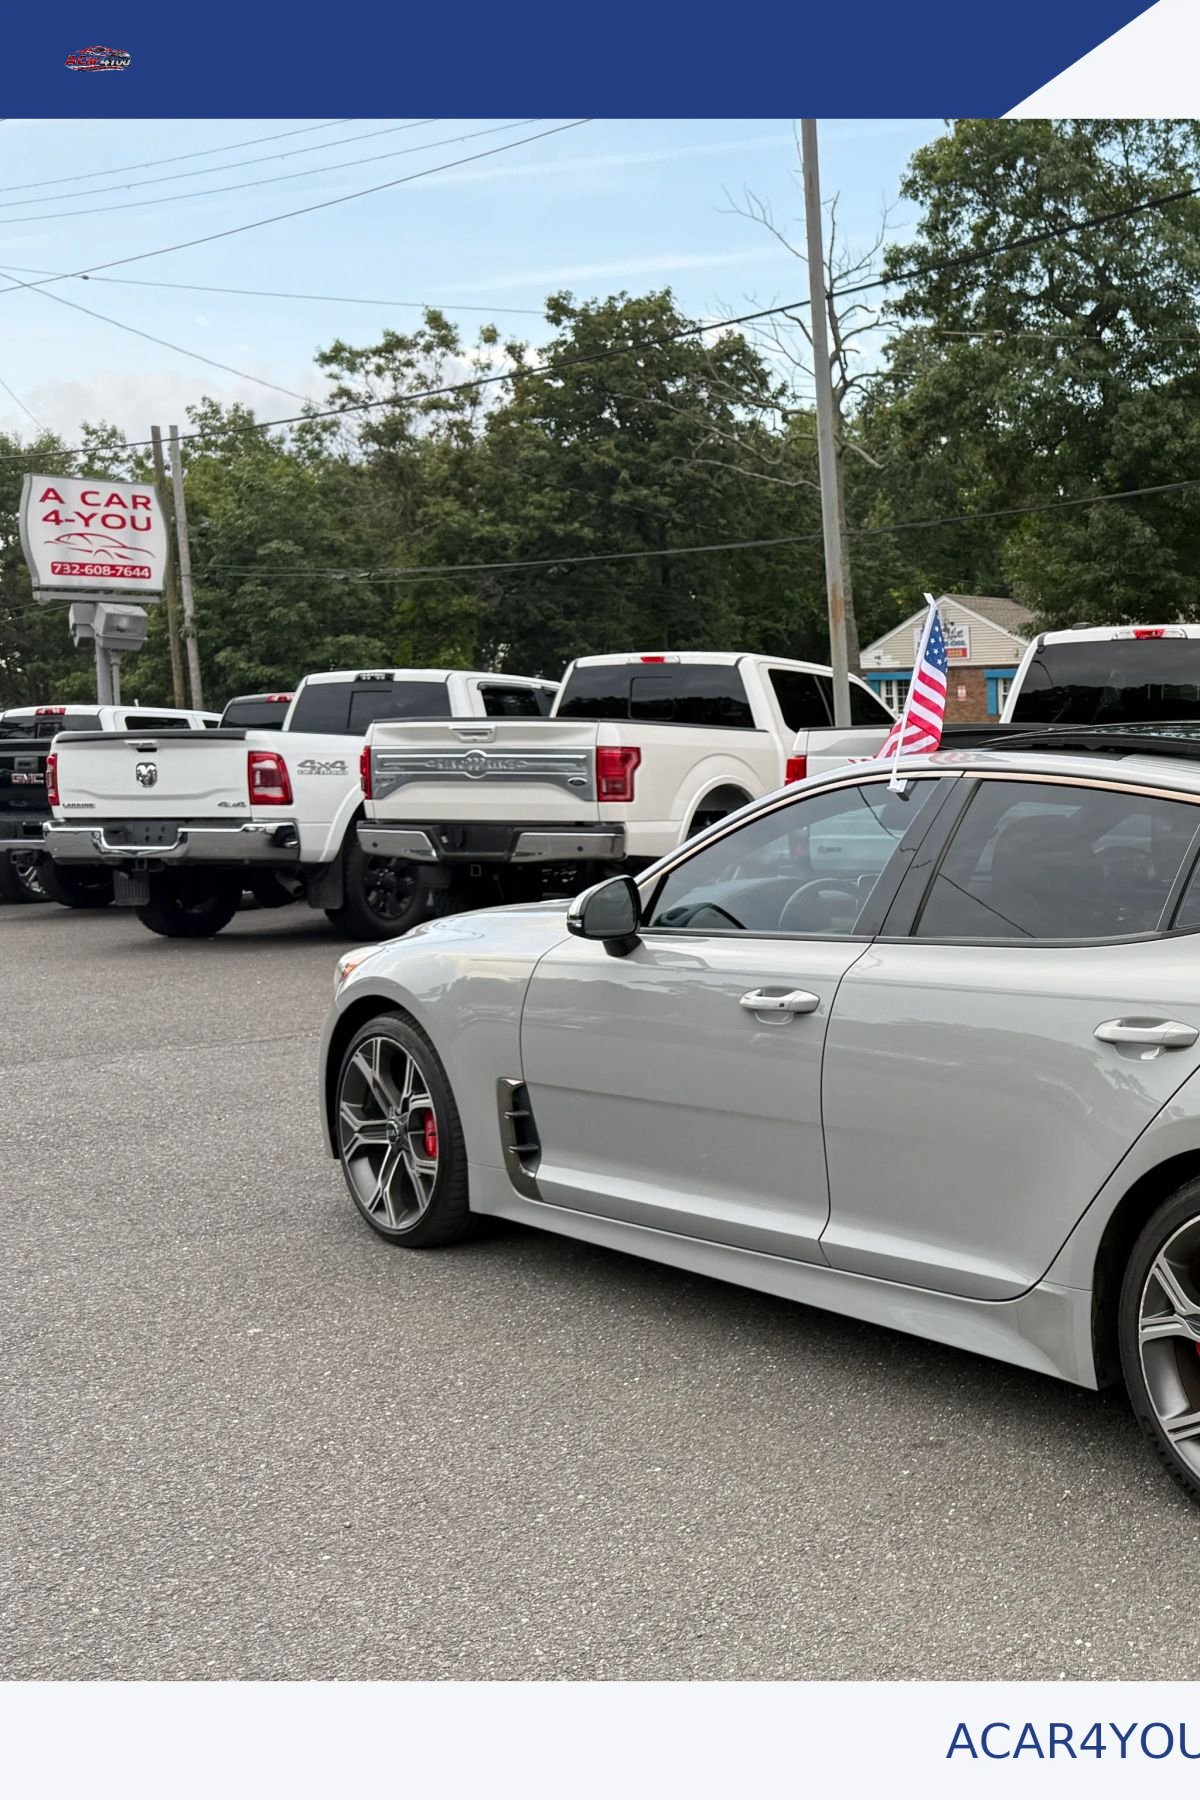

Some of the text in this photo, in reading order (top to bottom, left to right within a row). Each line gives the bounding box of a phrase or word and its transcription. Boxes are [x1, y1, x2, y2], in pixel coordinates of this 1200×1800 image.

[39, 487, 152, 511] A CAR
[42, 509, 152, 532] 4-YOU
[53, 563, 150, 578] 732-608-7644
[11, 773, 44, 784] GMC
